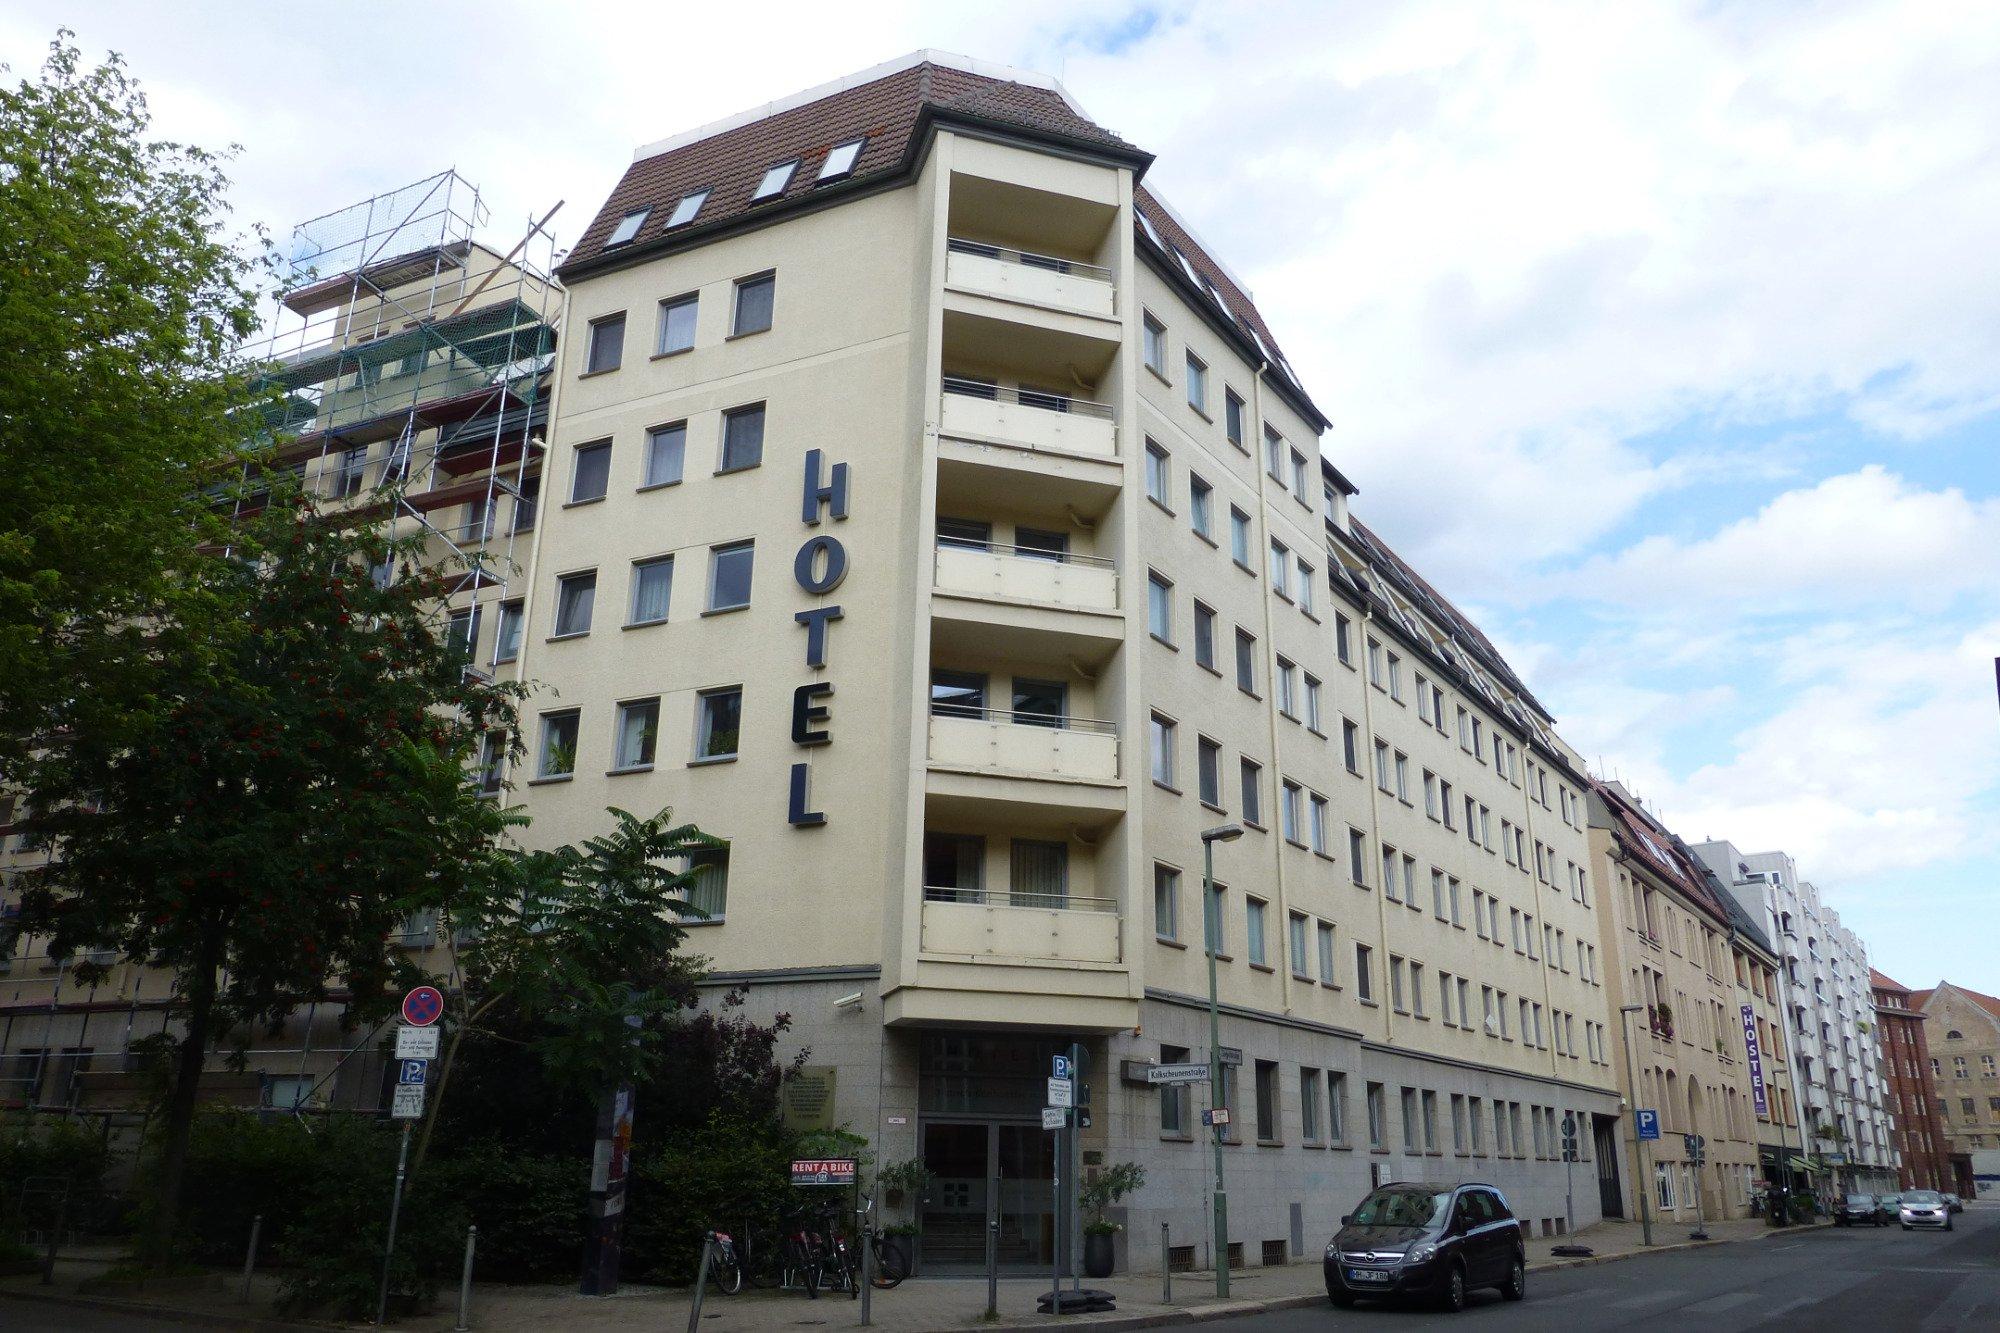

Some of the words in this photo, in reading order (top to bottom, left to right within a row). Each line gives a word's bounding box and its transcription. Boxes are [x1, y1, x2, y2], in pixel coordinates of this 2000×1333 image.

[788, 448, 852, 827] HOTEL
[1151, 1067, 1206, 1079] Kalkscheunenstraße
[1743, 1014, 1764, 1103] HOSTEL
[792, 1163, 819, 1172] RENT
[821, 1163, 829, 1172] A
[830, 1163, 854, 1171] BIKE
